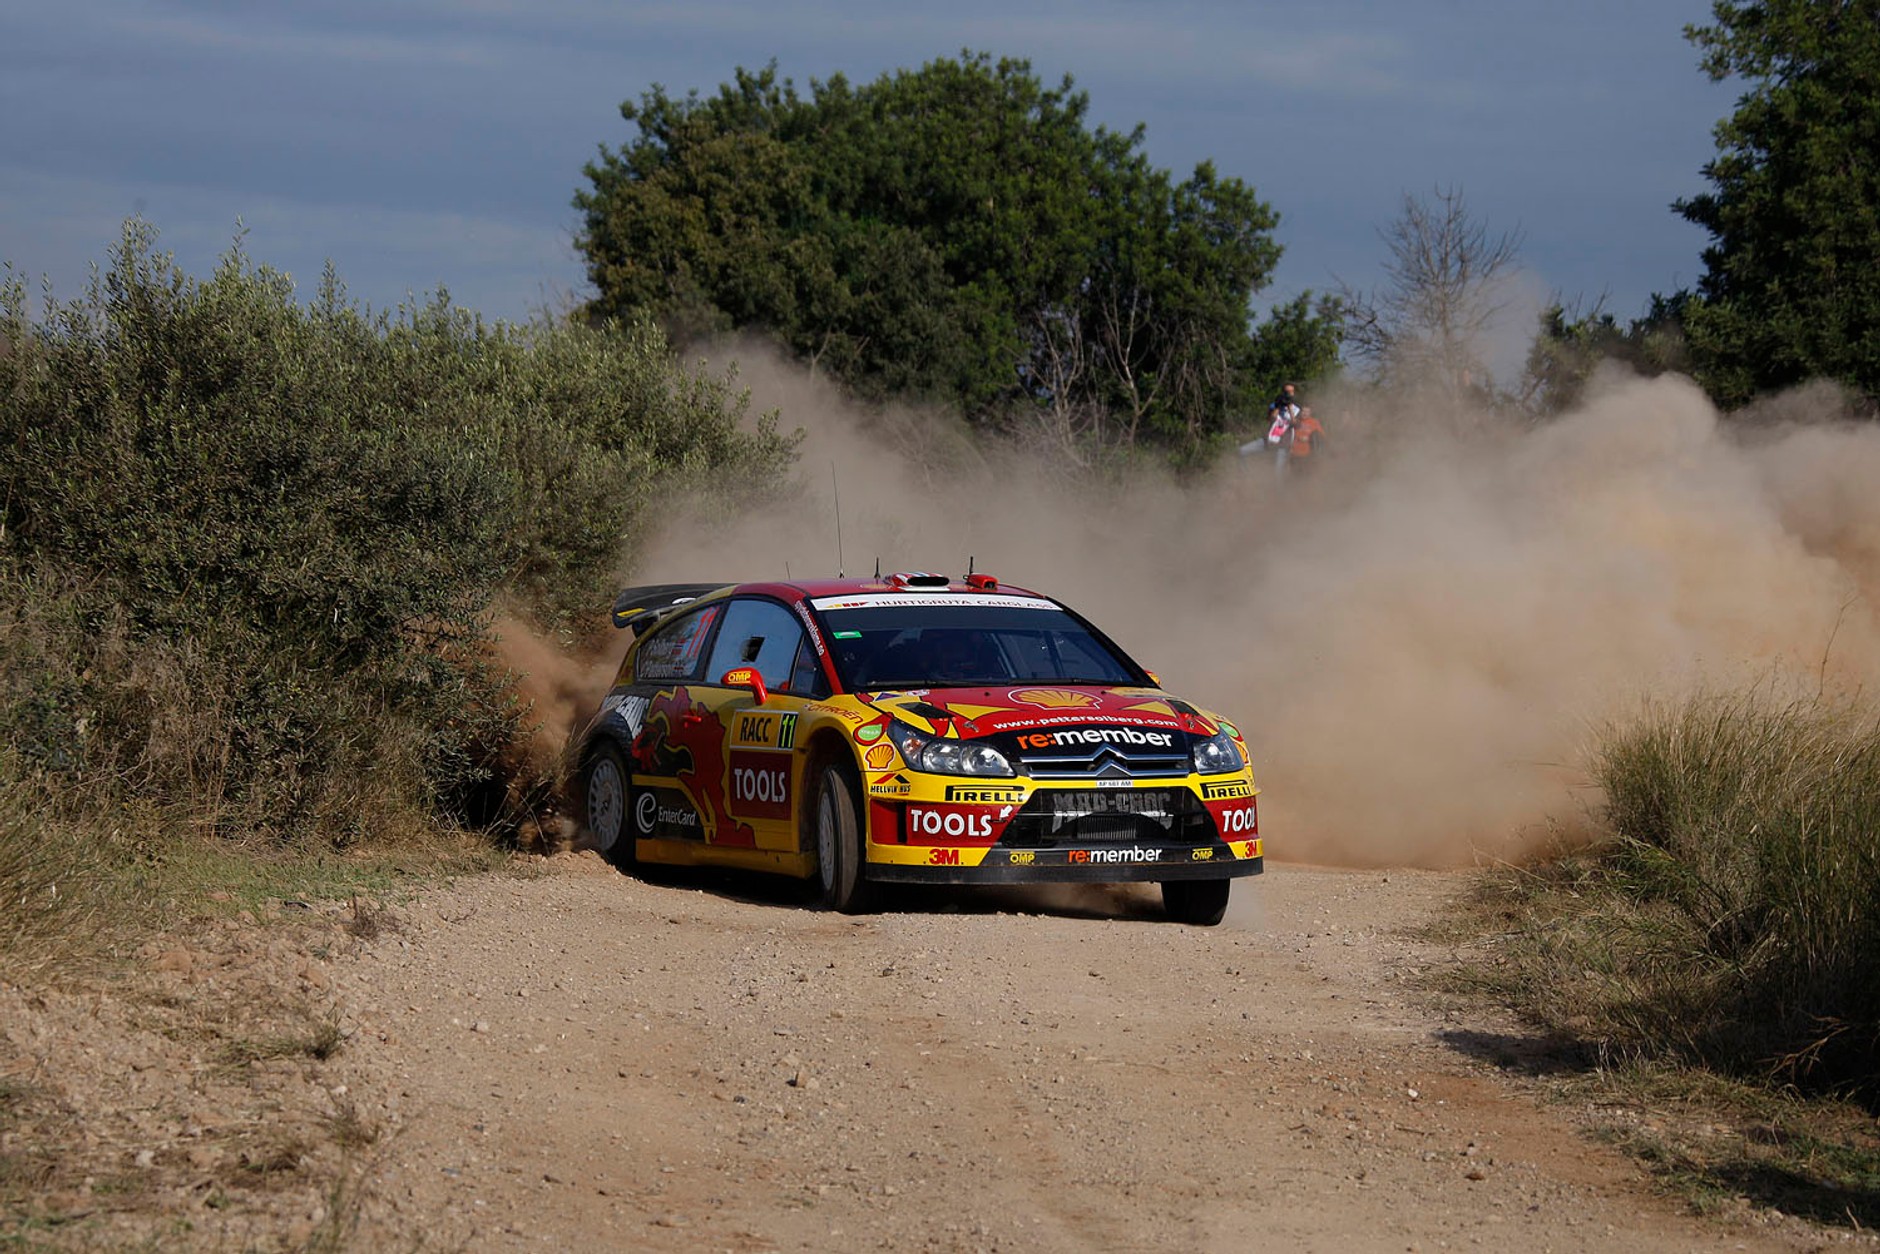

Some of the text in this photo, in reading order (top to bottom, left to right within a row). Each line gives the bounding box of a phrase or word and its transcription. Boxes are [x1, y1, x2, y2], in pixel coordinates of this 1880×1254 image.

[727, 671, 751, 682] OMP
[740, 714, 796, 748] RACC 11
[993, 715, 1179, 729] www.pettersolberg.com
[1017, 727, 1172, 750] re:member
[734, 768, 786, 803] TOOLS
[945, 784, 1025, 802] PIRELLI
[658, 806, 697, 826] EnterCard
[911, 809, 993, 837] TOOLS
[929, 849, 959, 865] 3M
[1009, 852, 1035, 864] OMP
[1068, 845, 1162, 863] re:member
[1192, 849, 1213, 860] OMP
